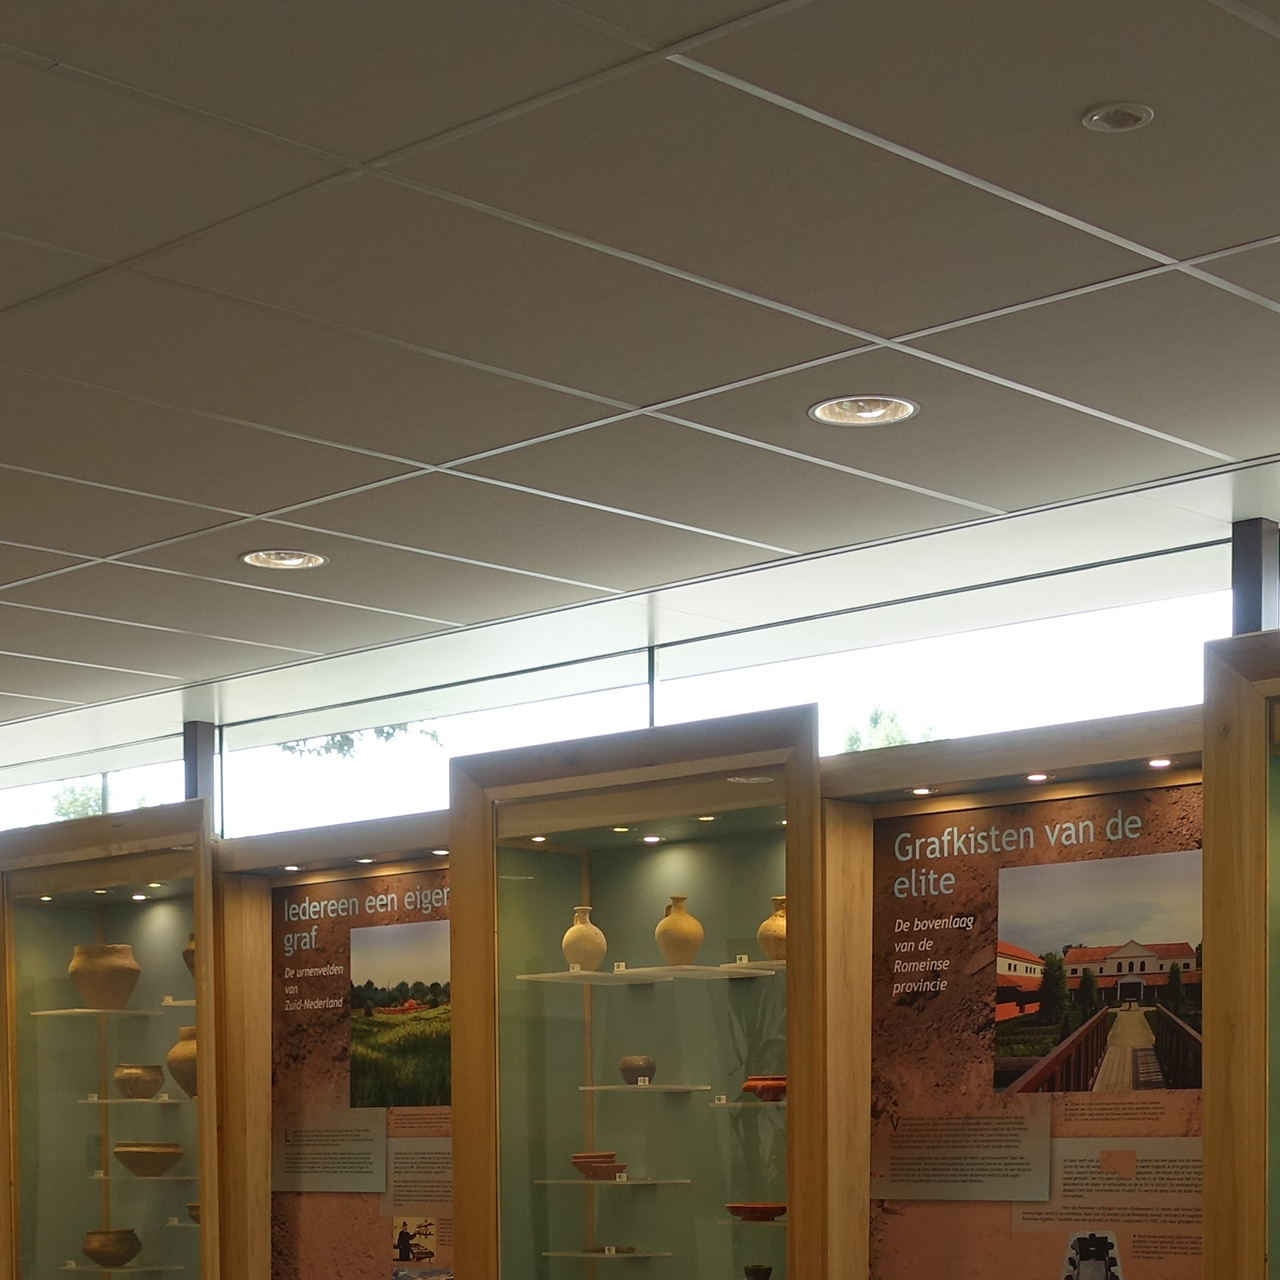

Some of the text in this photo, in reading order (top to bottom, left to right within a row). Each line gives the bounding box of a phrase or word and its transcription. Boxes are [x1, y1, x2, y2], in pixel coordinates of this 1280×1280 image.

[894, 809, 1142, 862] Grafkisten van de
[893, 868, 956, 899] elite
[285, 897, 359, 922] Iedereen
[365, 893, 398, 913] een
[895, 914, 974, 933] De bovenlaag
[283, 925, 318, 958] graf
[894, 937, 933, 952] van de
[285, 964, 344, 978] De urnenvelden
[894, 956, 950, 973] Romeinse
[285, 984, 298, 995] van
[892, 977, 948, 996] provincie
[285, 996, 343, 1012] Zuid-Nederland
